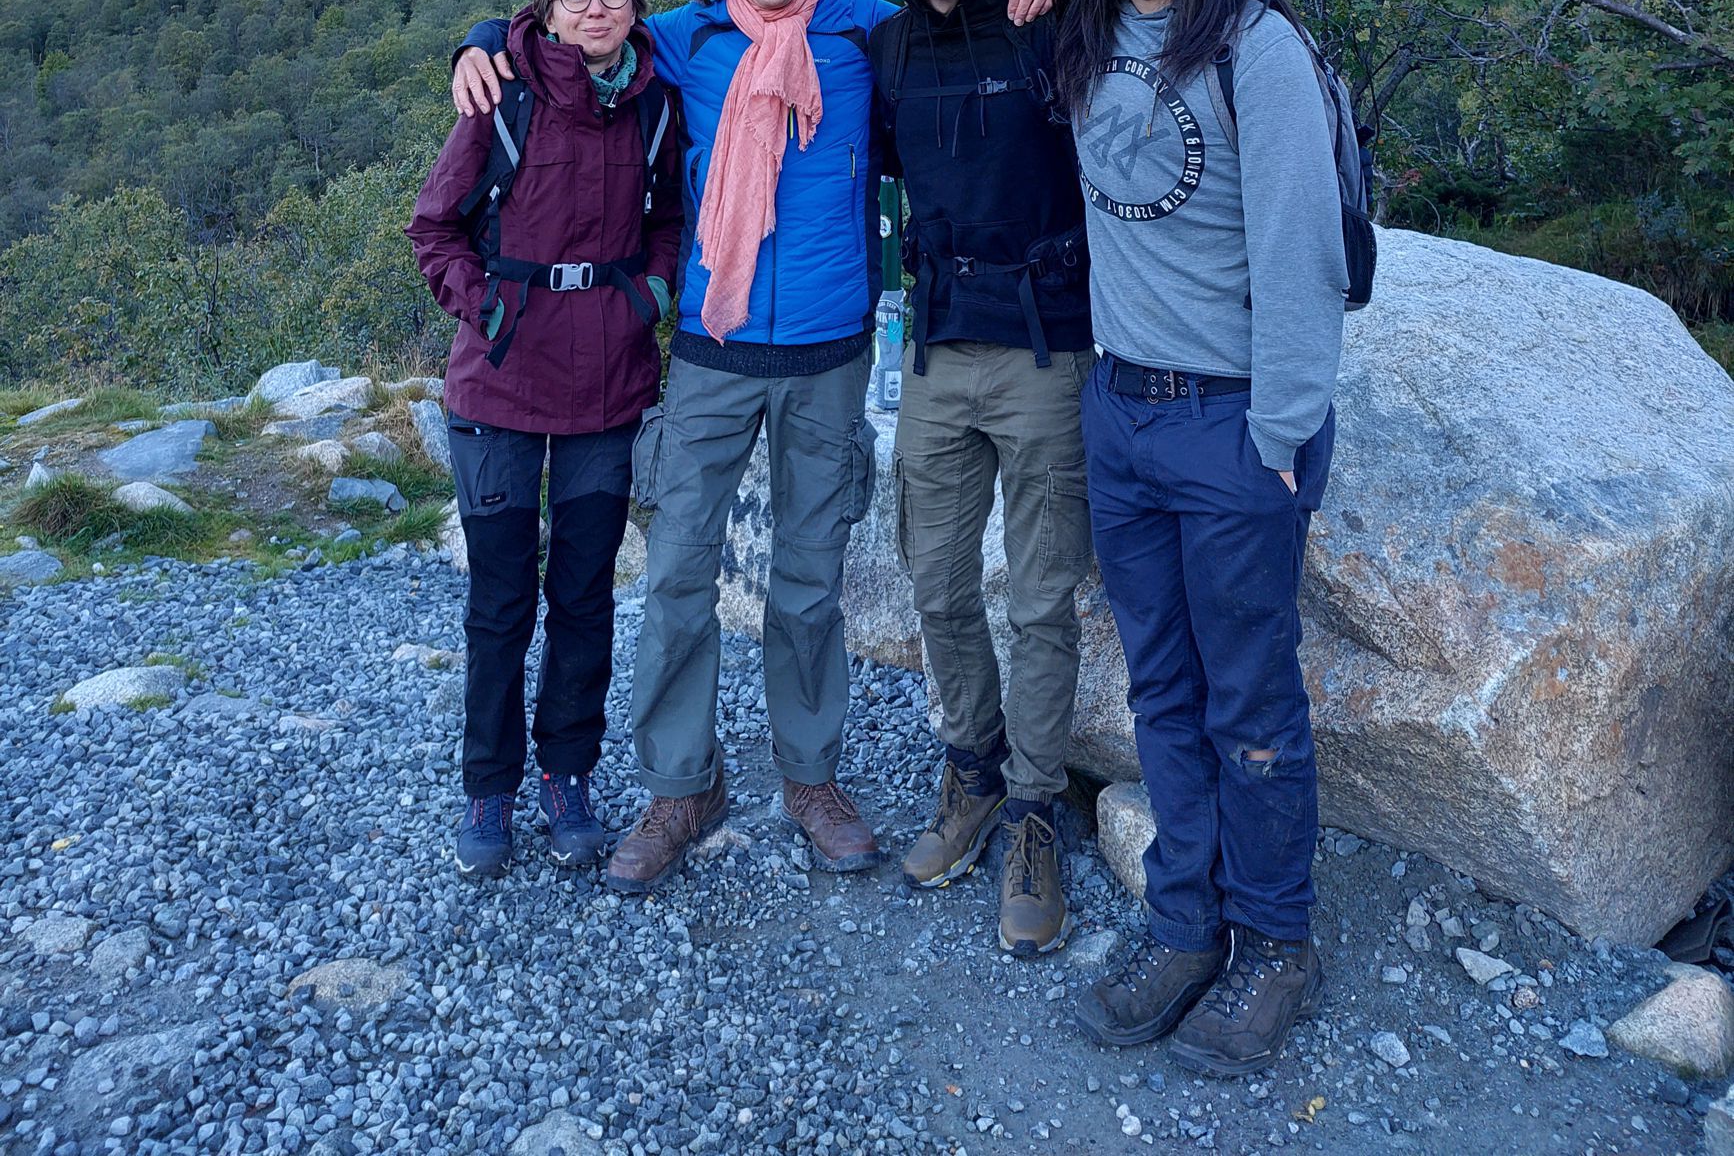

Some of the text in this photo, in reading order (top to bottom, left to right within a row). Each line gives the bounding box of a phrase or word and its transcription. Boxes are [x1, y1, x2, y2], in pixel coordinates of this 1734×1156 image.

[1125, 59, 1151, 80] CORE
[1168, 99, 1196, 132] JACK
[1185, 137, 1201, 145] &
[1183, 150, 1202, 186] JONES
